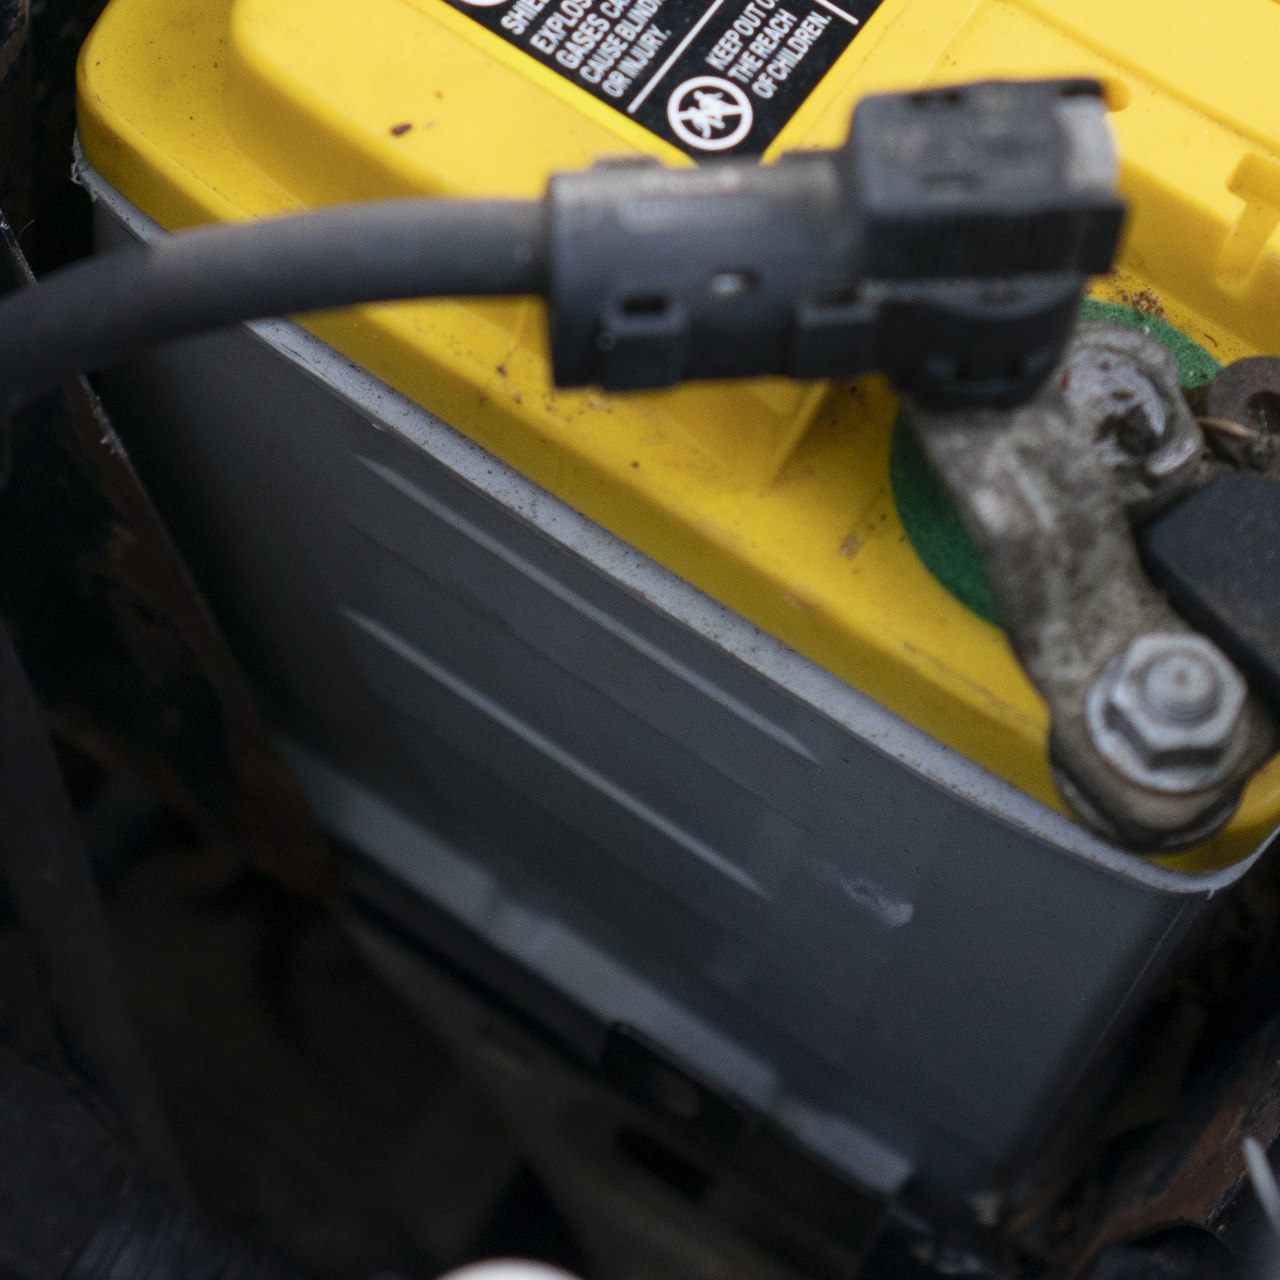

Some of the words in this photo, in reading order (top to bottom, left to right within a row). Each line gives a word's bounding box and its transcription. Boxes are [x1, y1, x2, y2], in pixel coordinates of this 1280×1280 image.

[555, 13, 610, 69] GASES
[579, 33, 629, 83] CAUSE
[601, 70, 632, 98] OR
[617, 23, 672, 79] INJURY.
[704, 29, 744, 71] KEEP
[733, 1, 767, 37] OUT
[727, 50, 764, 84] THE
[748, 7, 798, 60] REACH
[751, 72, 778, 100] OF
[766, 10, 832, 81] CHILDREN.
